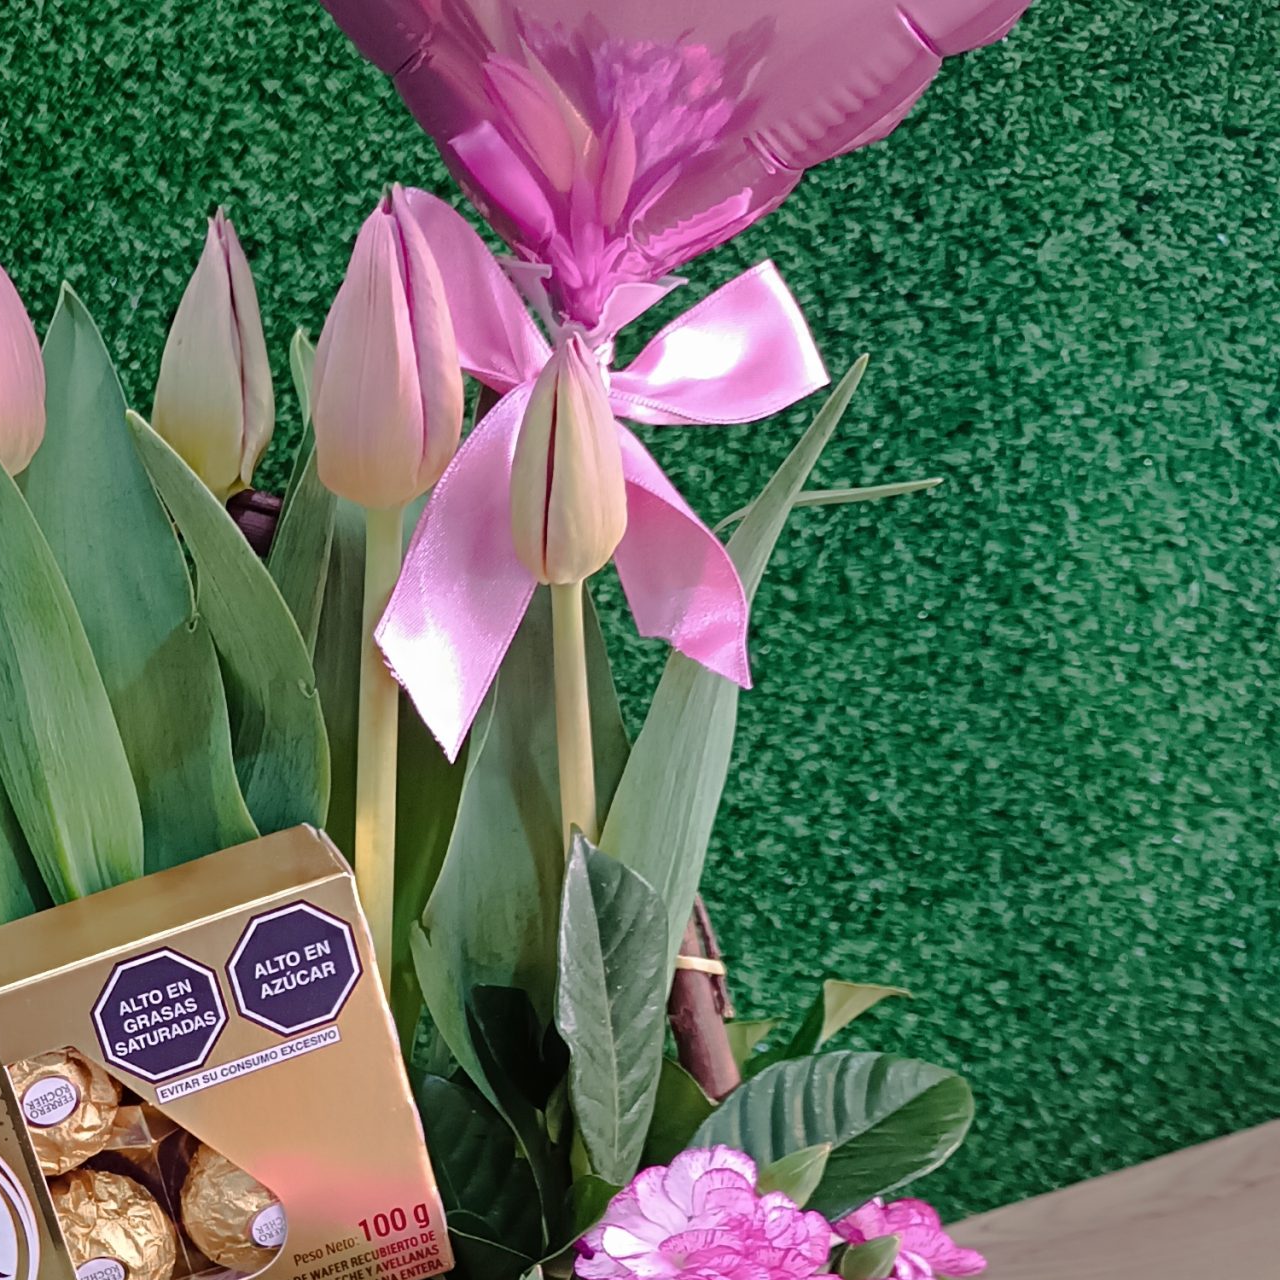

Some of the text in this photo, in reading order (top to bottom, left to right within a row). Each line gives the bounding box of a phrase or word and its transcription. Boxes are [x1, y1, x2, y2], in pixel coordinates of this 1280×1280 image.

[254, 940, 332, 980] ALTO EN
[119, 979, 192, 1017] ALTO EN
[259, 961, 336, 1000] AZÚCAR
[115, 1011, 217, 1057] SATURADAS
[123, 998, 198, 1035] GRASAS
[160, 1029, 337, 1100] EVITAR SU CONSUMO EXCESIVO
[25, 1083, 71, 1110] ROCHER
[30, 1092, 75, 1119] FERRERO
[293, 1203, 430, 1267] Peso Neto: 100 g
[350, 1236, 419, 1267] RECUBIERTO
[420, 1230, 436, 1244] DE
[366, 1265, 376, 1278] Y
[375, 1244, 440, 1276] AVELLANAS
[400, 1258, 444, 1280] ENTERA
